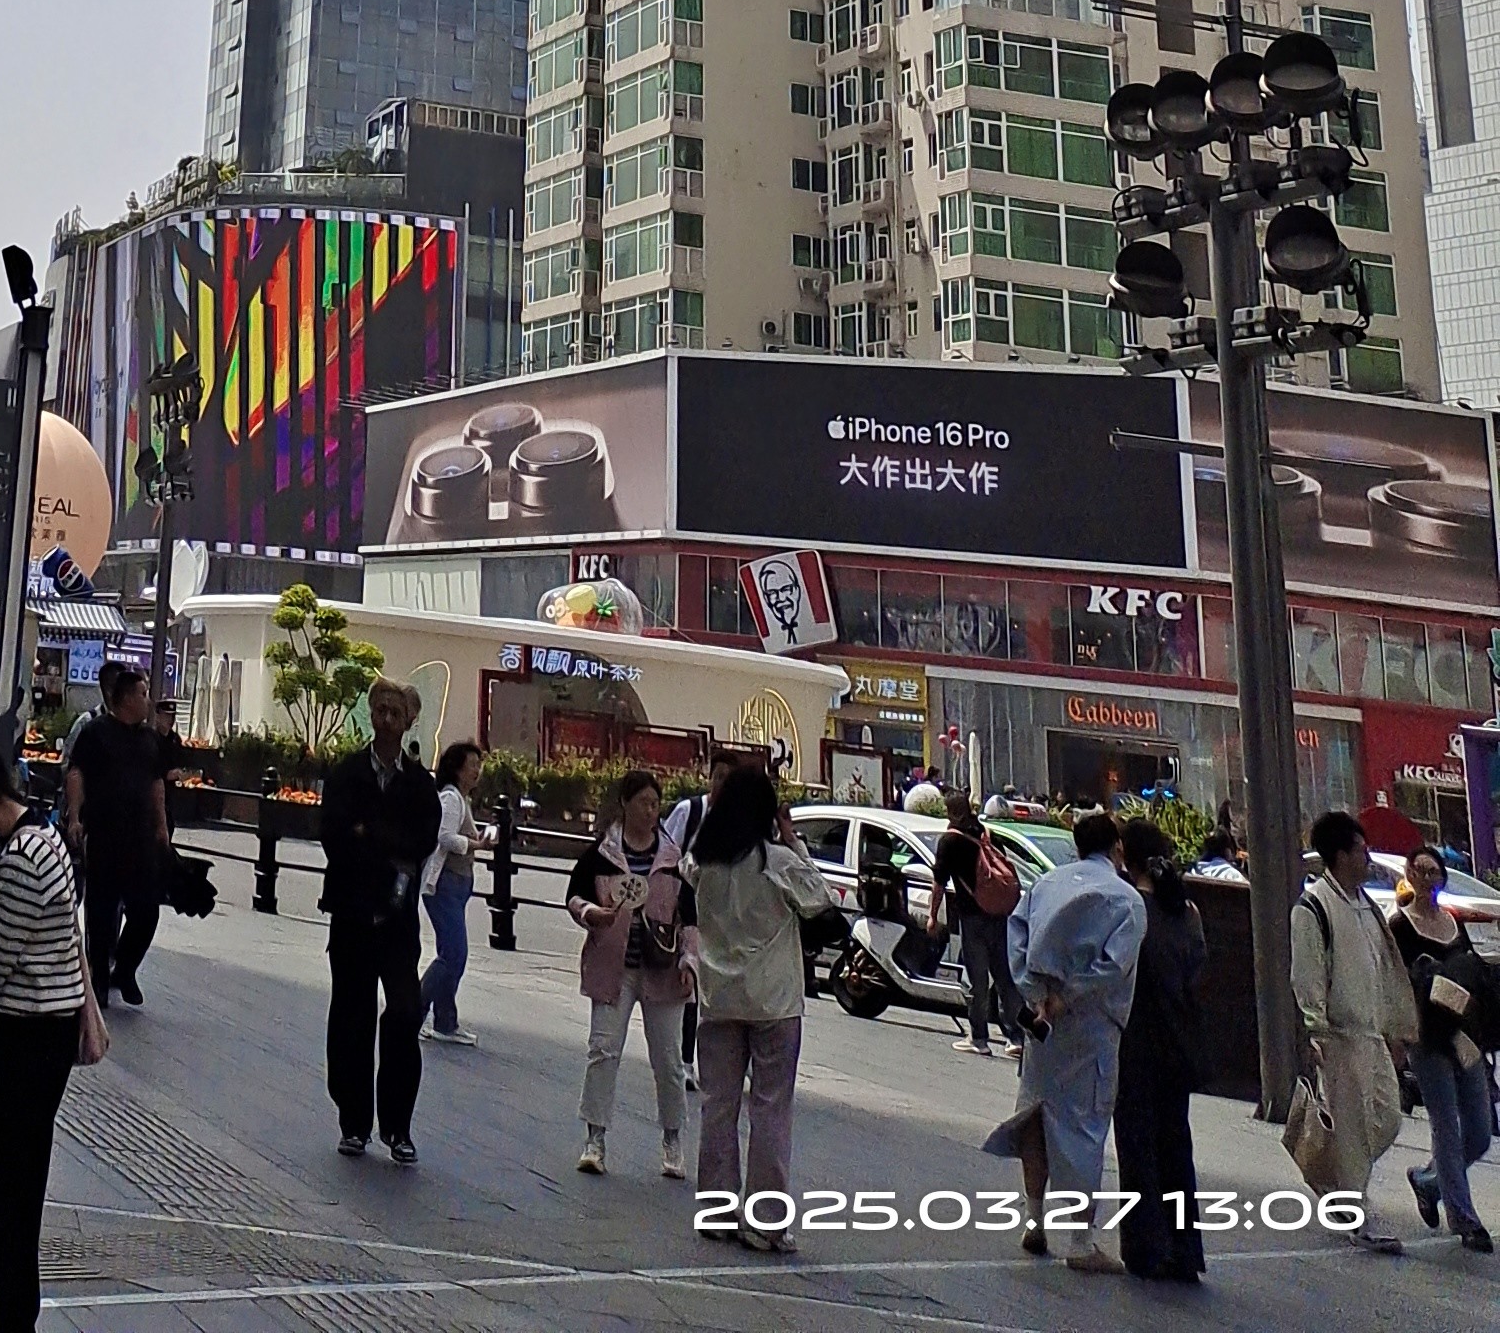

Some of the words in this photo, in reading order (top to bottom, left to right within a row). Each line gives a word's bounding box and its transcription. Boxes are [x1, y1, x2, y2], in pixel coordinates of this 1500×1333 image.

[848, 417, 931, 444] iPhone
[935, 421, 963, 446] 16
[968, 424, 1010, 449] Pro
[839, 453, 999, 495] 大作出大作
[578, 555, 610, 579] KFC
[1087, 585, 1183, 620] KFC
[1067, 695, 1158, 729] Cabbeen
[1403, 763, 1436, 781] KFC
